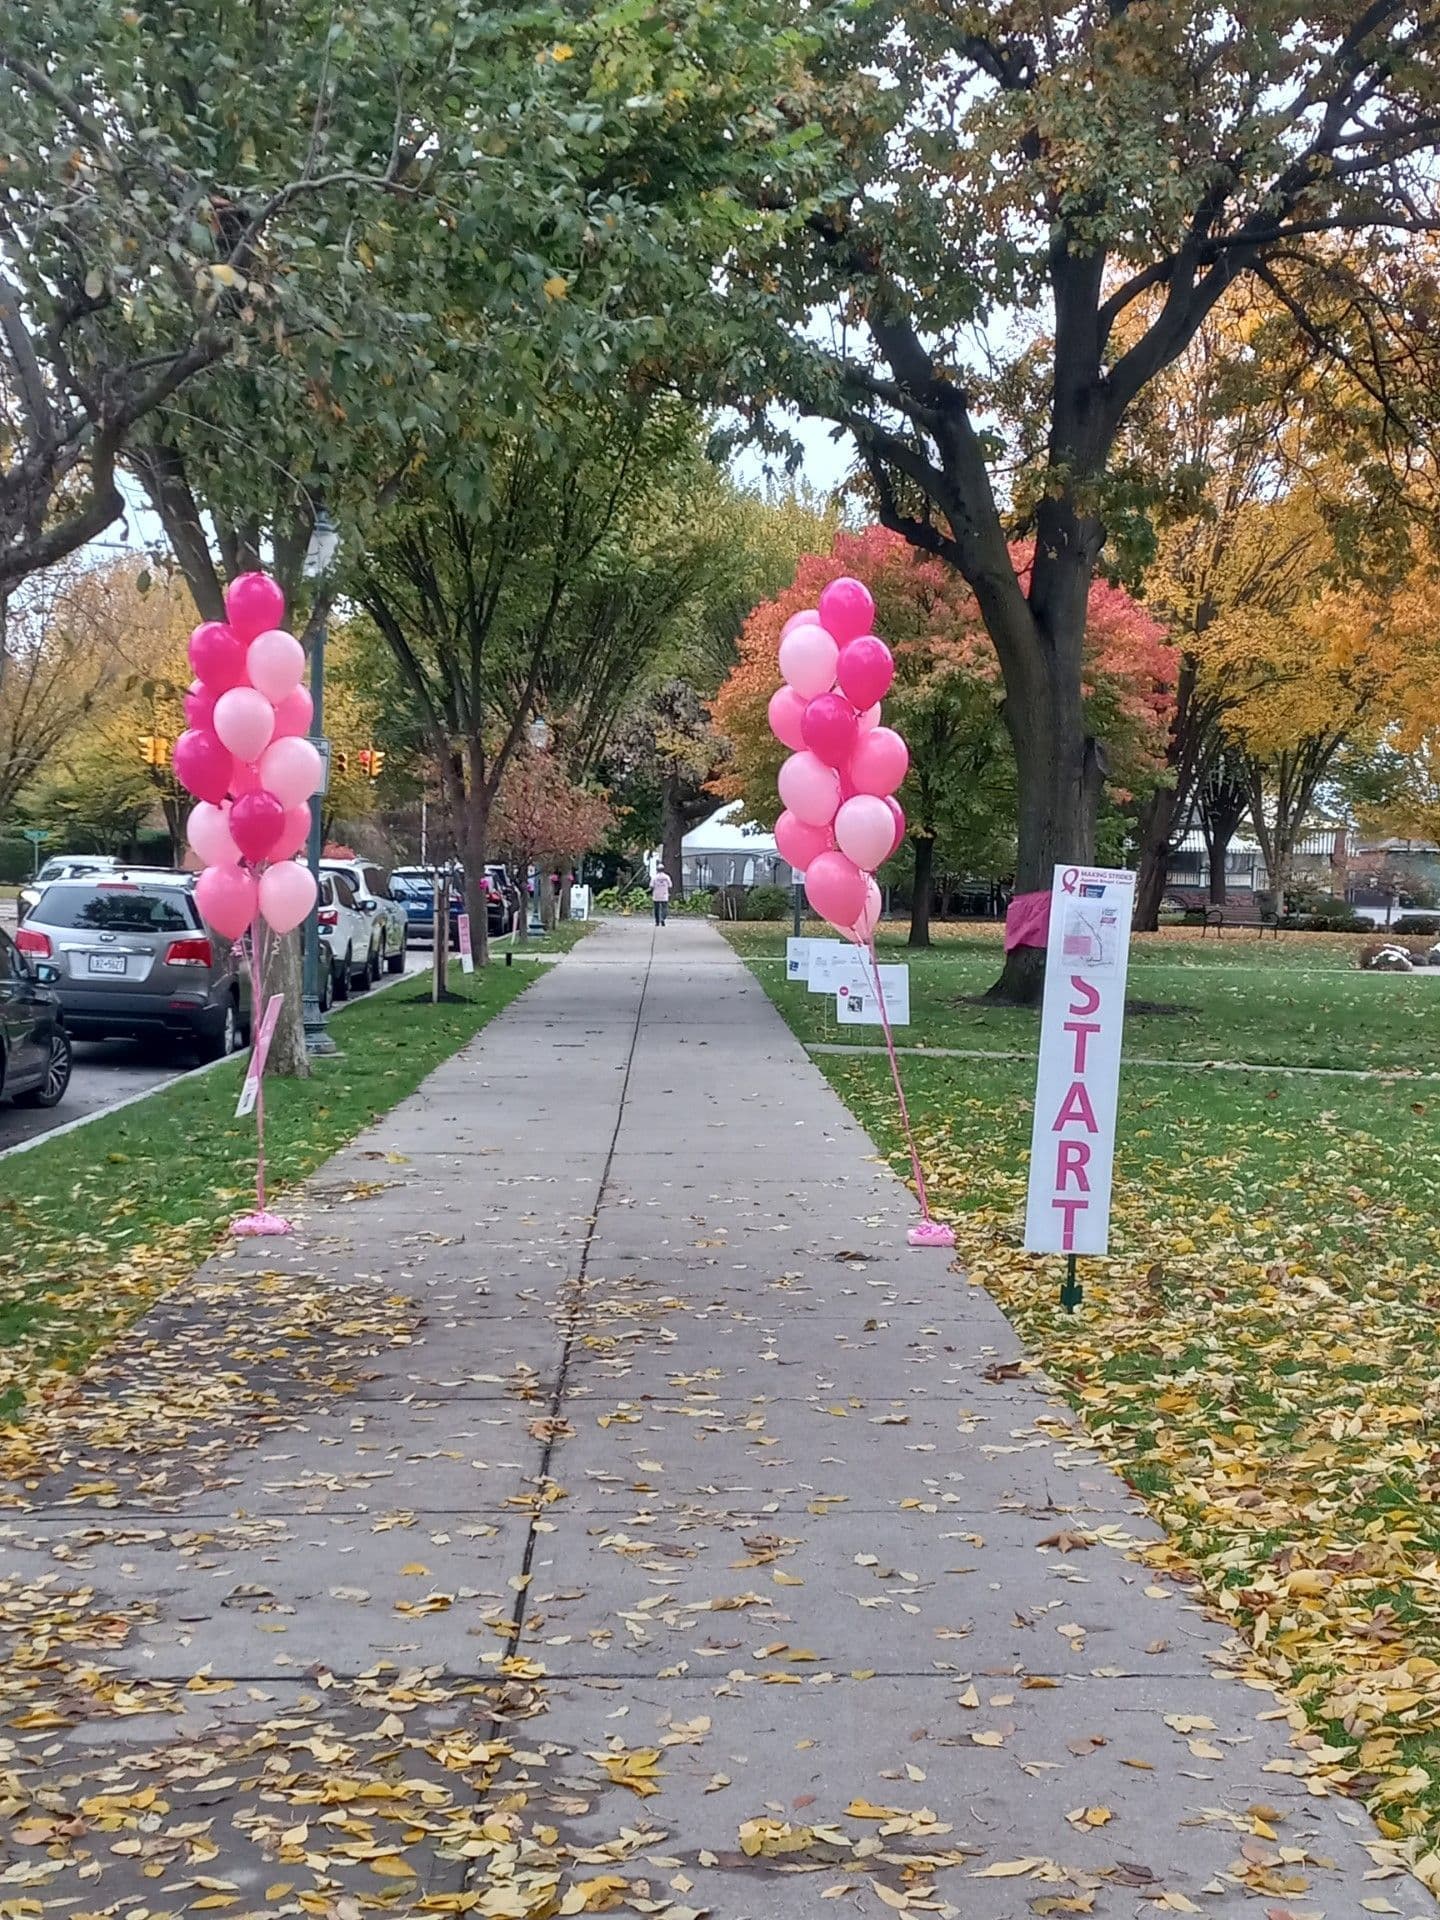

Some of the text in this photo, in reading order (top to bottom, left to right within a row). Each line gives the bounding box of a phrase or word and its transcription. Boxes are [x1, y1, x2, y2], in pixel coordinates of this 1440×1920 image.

[1081, 871, 1133, 881] MAKING STRIDES
[1052, 975, 1101, 1250] START
